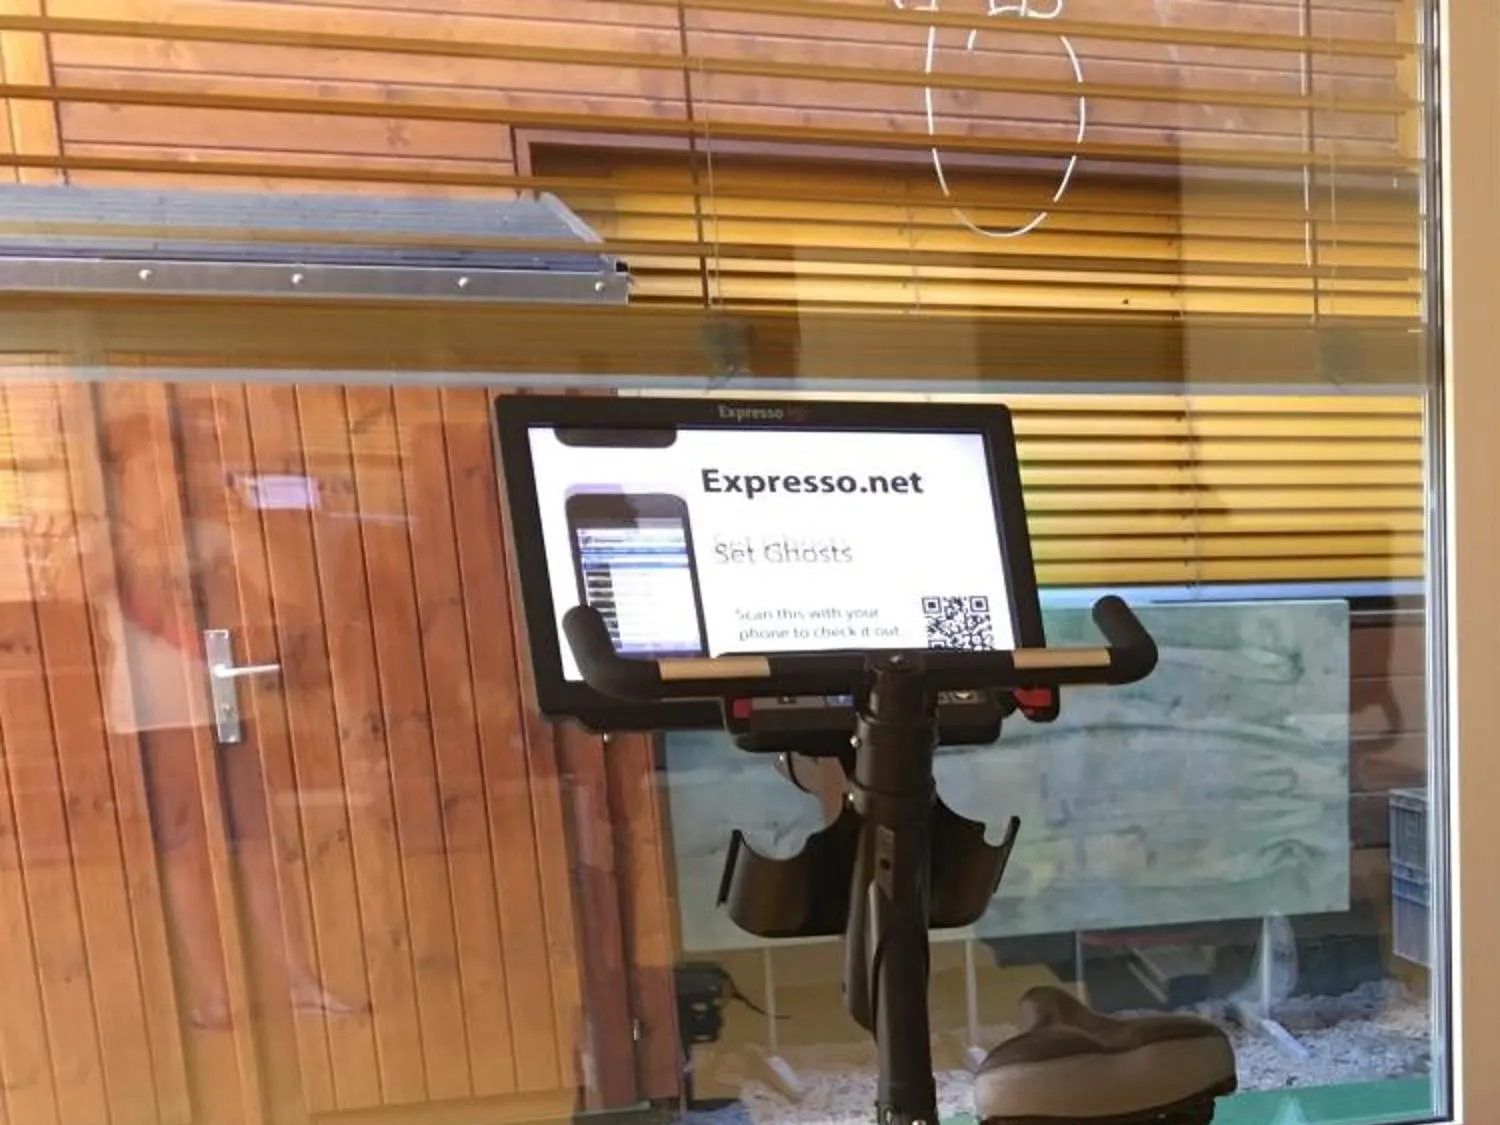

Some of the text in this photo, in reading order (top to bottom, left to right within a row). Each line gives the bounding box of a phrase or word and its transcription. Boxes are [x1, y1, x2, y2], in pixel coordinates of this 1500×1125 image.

[718, 405, 784, 422] Expresso
[701, 467, 924, 499] Expresso.net
[714, 540, 854, 565] Set Ghosts
[735, 607, 880, 624] Scan this with your
[739, 628, 790, 642] phone
[793, 627, 810, 639] to
[813, 625, 855, 638] check
[861, 625, 870, 638] it
